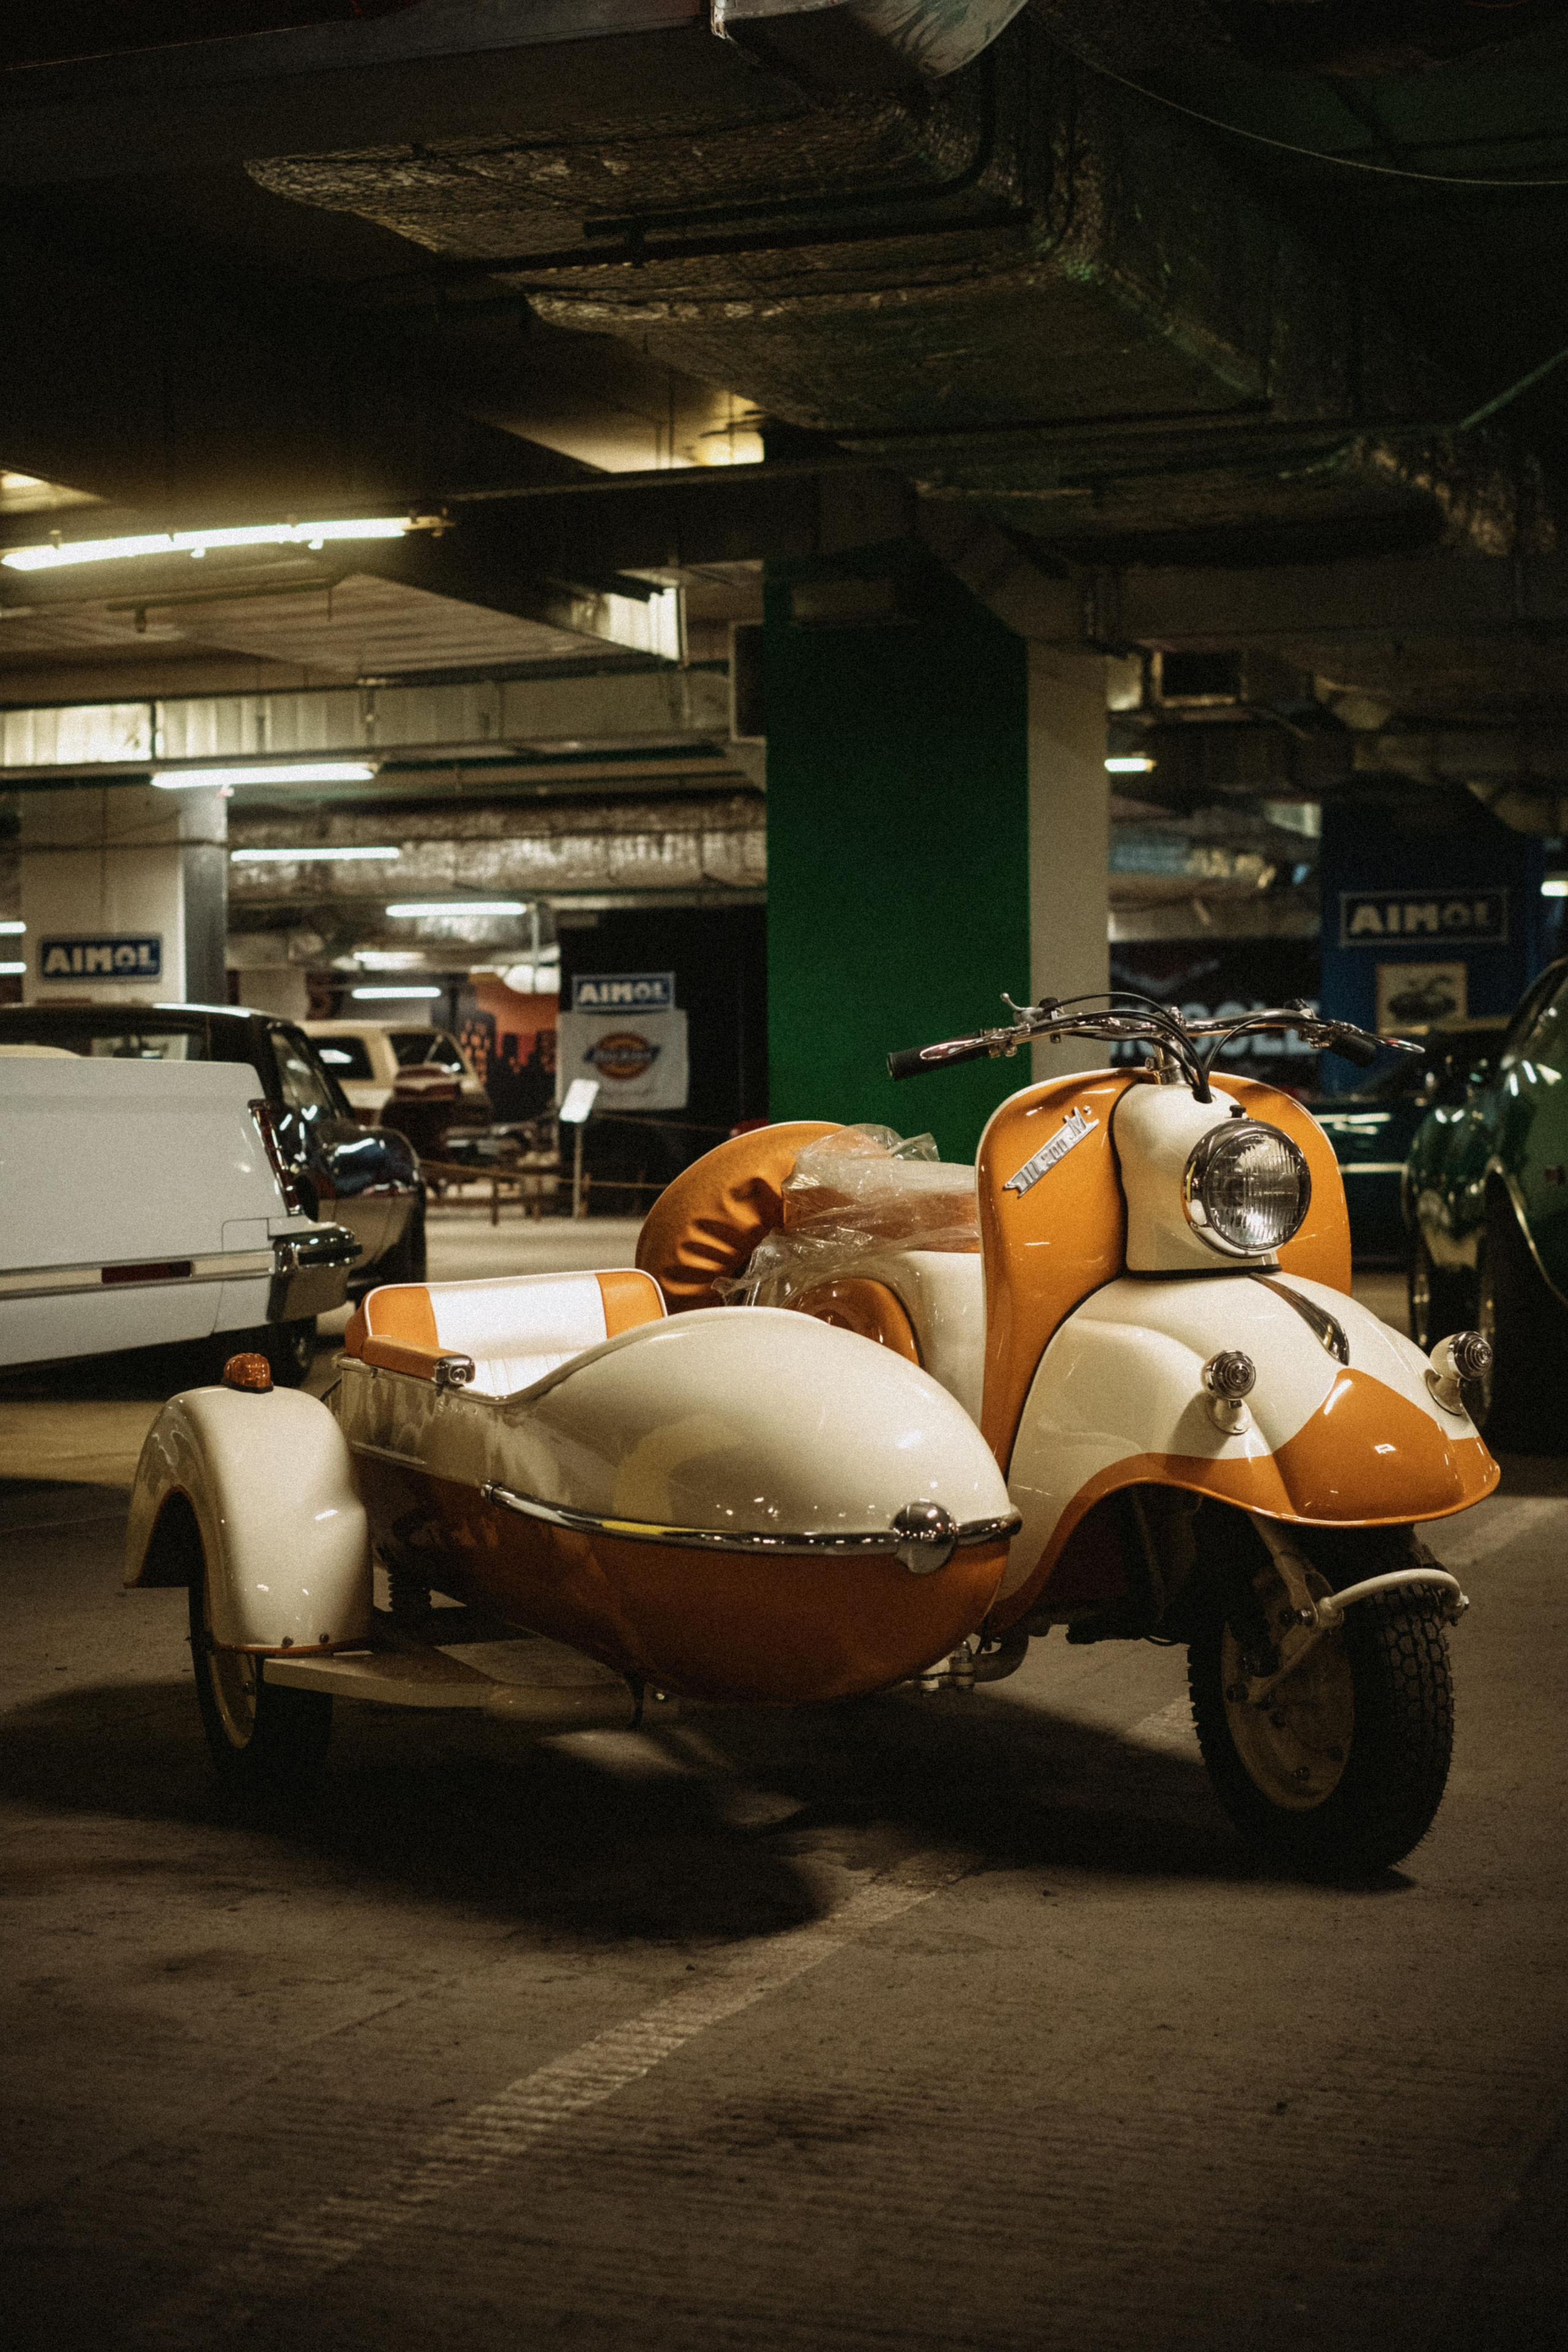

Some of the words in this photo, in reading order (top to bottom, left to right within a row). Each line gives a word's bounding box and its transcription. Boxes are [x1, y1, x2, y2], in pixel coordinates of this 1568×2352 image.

[1350, 903, 1491, 934] AIMOL
[45, 946, 156, 973] AIMOL
[579, 982, 668, 1003] AIMOL
